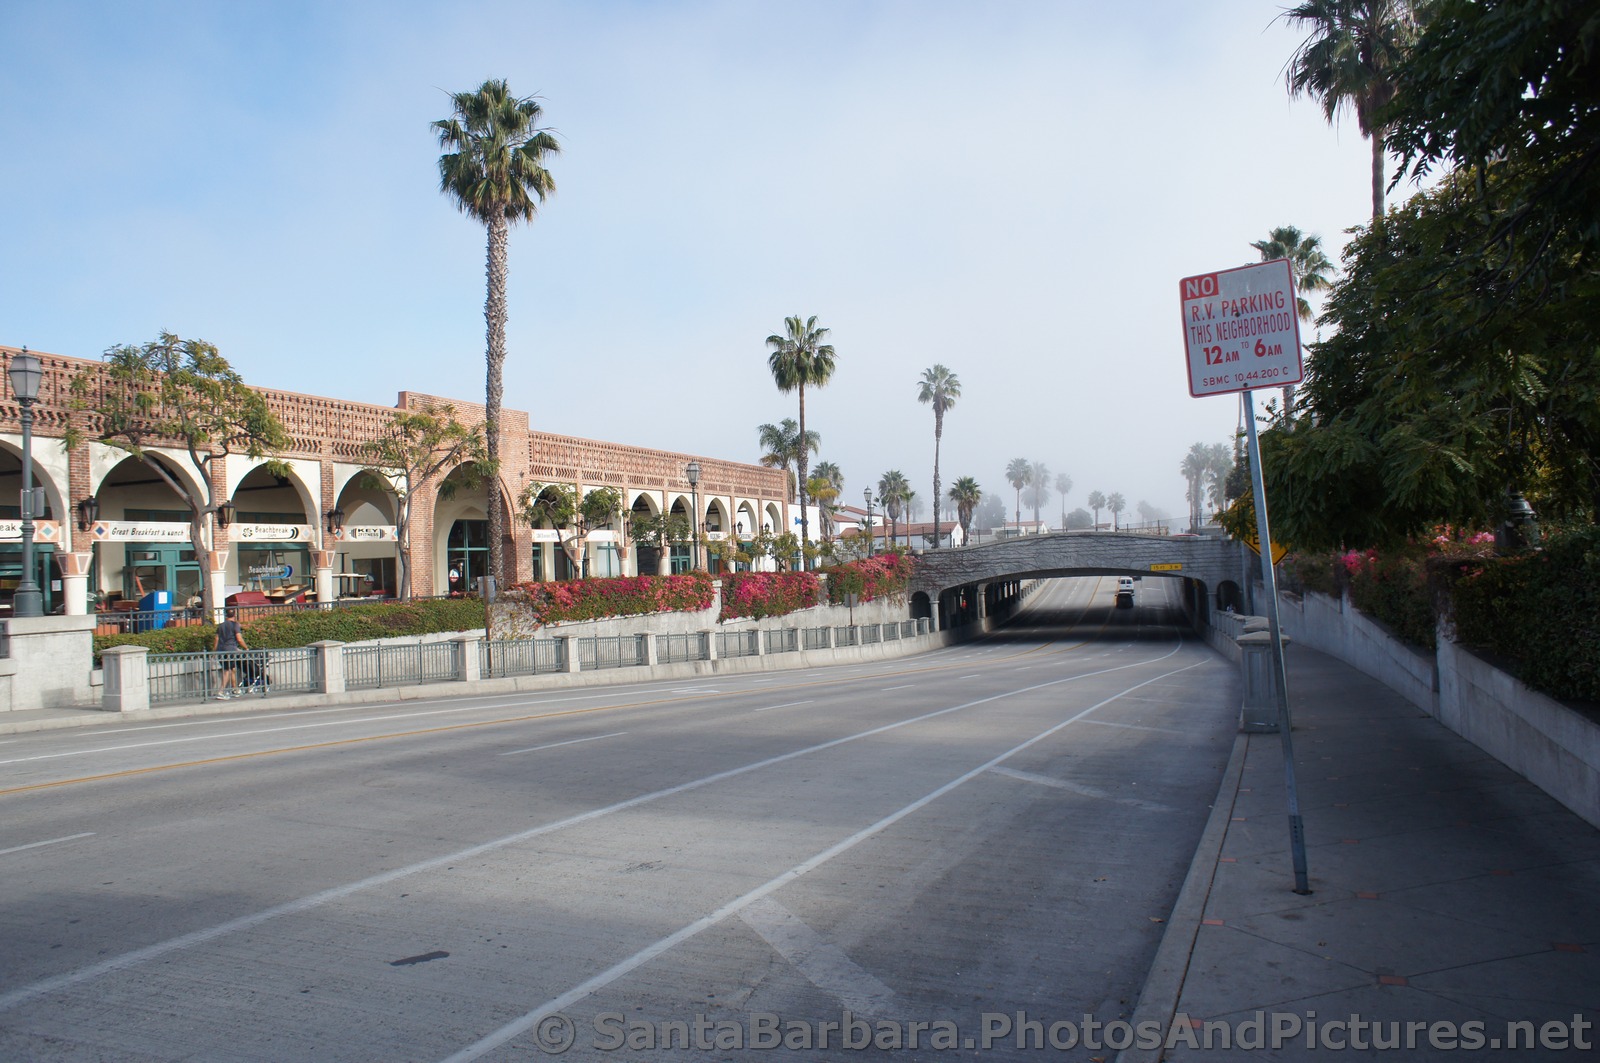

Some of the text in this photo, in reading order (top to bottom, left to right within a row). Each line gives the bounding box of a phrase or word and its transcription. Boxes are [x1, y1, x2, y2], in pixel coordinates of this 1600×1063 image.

[1185, 276, 1215, 298] NO
[1191, 291, 1285, 322] R.V. PARKING
[1190, 312, 1291, 345] THIS NEIGHBORHOOD
[1241, 341, 1250, 350] TO
[1202, 366, 1289, 387] SBMC 10.44.200 C
[111, 527, 129, 536] Great
[130, 527, 160, 536] Breakfast
[254, 525, 289, 534] Beachbreak
[248, 565, 282, 573] Beachbreak
